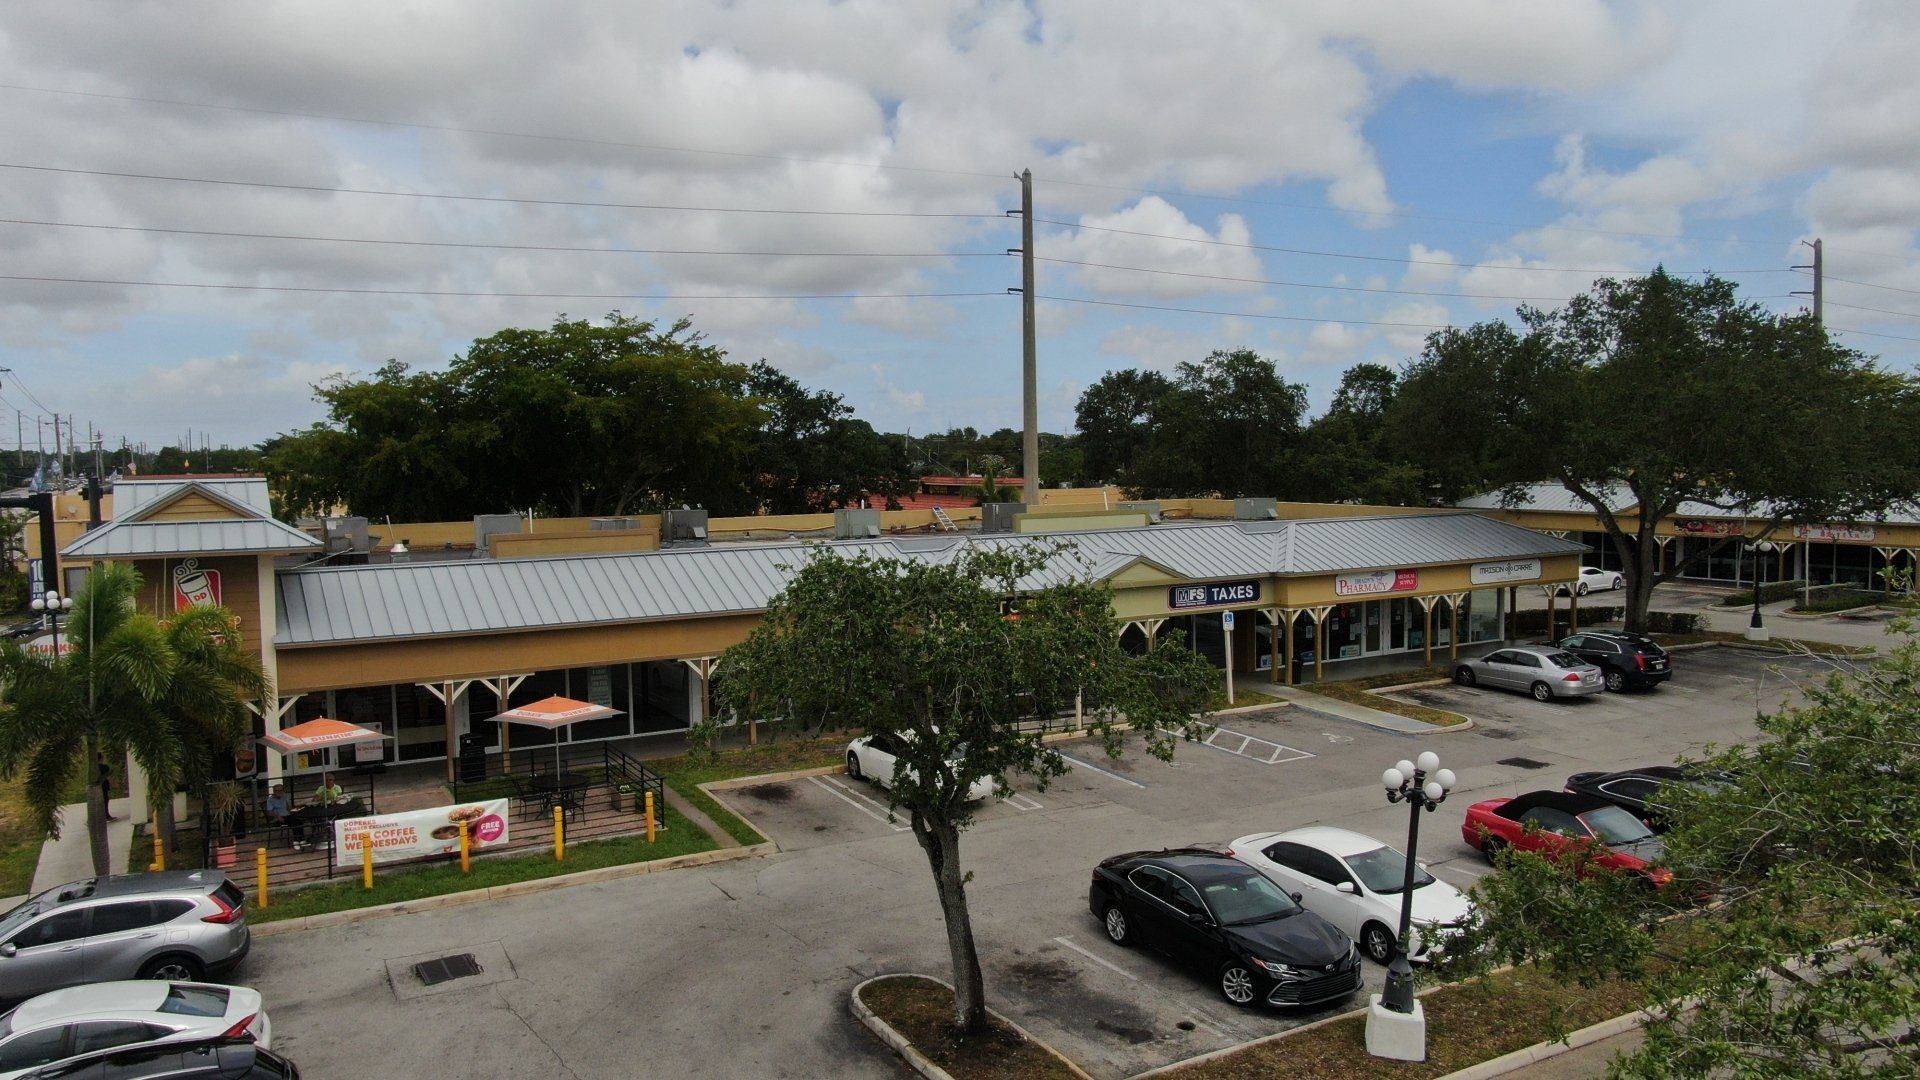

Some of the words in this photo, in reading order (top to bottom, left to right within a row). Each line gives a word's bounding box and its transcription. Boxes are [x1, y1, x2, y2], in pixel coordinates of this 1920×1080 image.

[1211, 584, 1254, 601] TAXES
[1339, 580, 1388, 595] PHARMACY
[194, 592, 207, 602] DD
[481, 821, 500, 830] FREE
[373, 827, 415, 839] COFFEE
[345, 835, 418, 851] WENESDAYS
